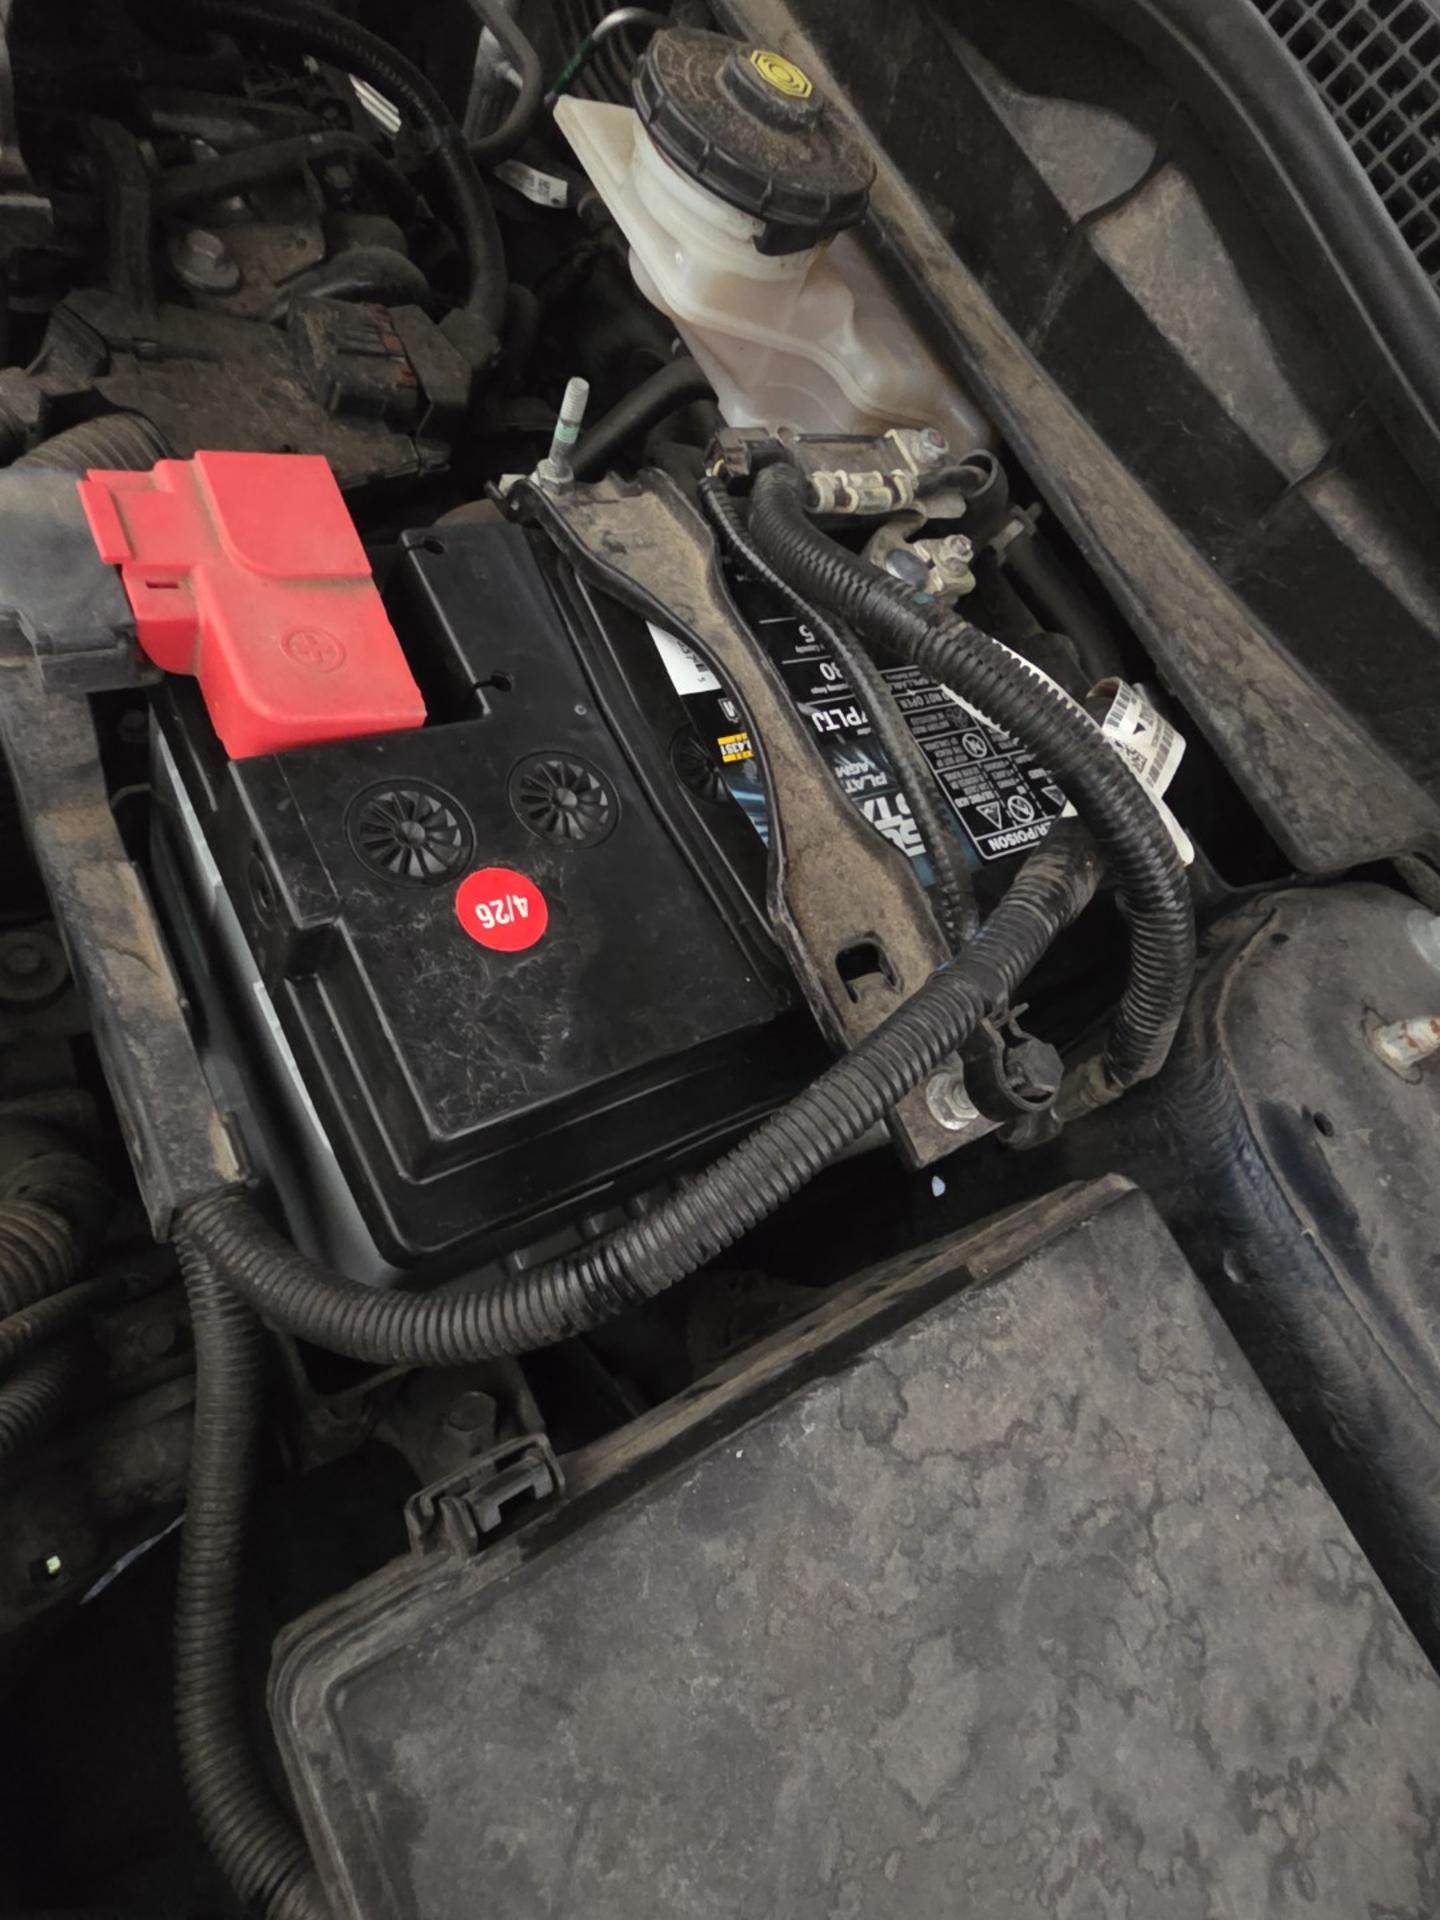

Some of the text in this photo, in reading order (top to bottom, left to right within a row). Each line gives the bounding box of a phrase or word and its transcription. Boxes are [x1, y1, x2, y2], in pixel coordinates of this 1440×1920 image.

[835, 762, 869, 778] AGM
[841, 772, 887, 793] PLAT
[988, 821, 1052, 851] R/POISON
[475, 894, 528, 928] 4/26
